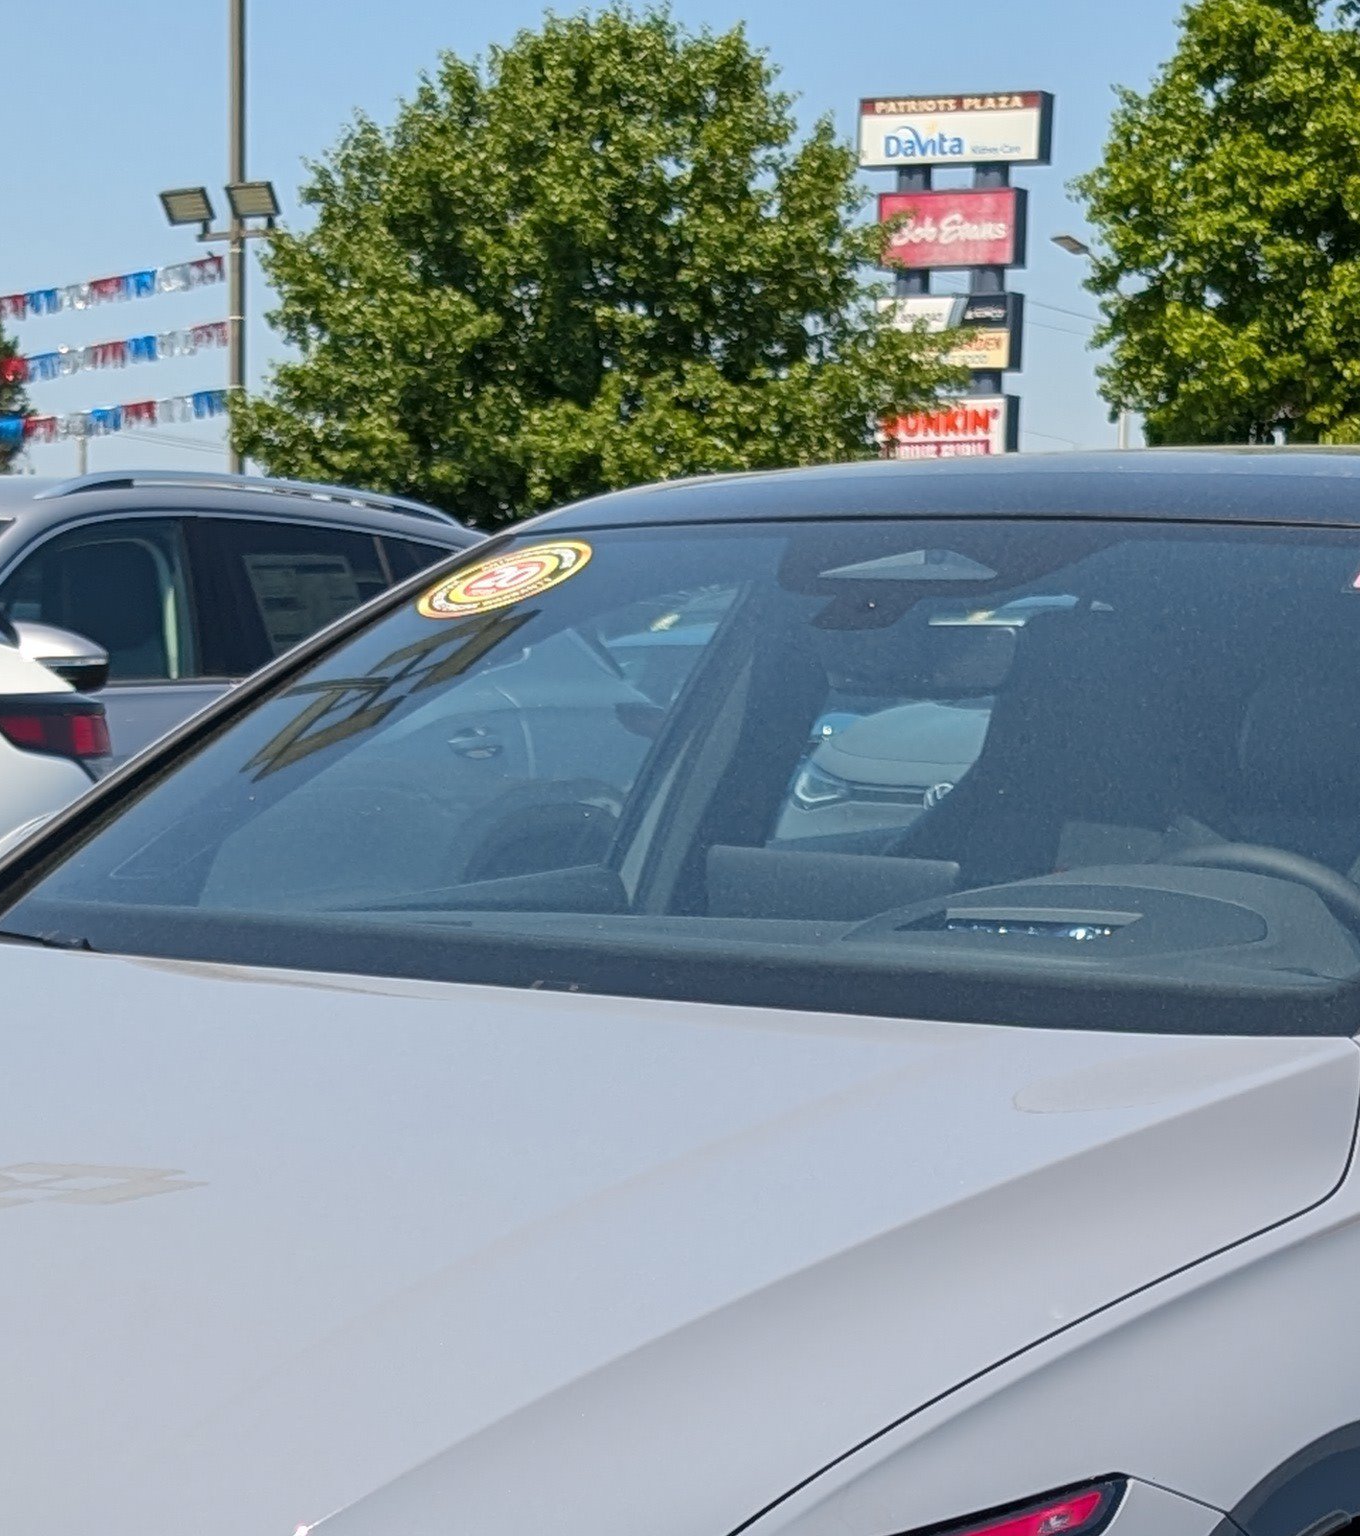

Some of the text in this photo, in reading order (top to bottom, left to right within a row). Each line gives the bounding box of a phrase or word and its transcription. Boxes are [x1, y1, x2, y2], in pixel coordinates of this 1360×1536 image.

[874, 96, 1024, 114] PATRIOTS PLAZA
[884, 126, 964, 158] DaVita
